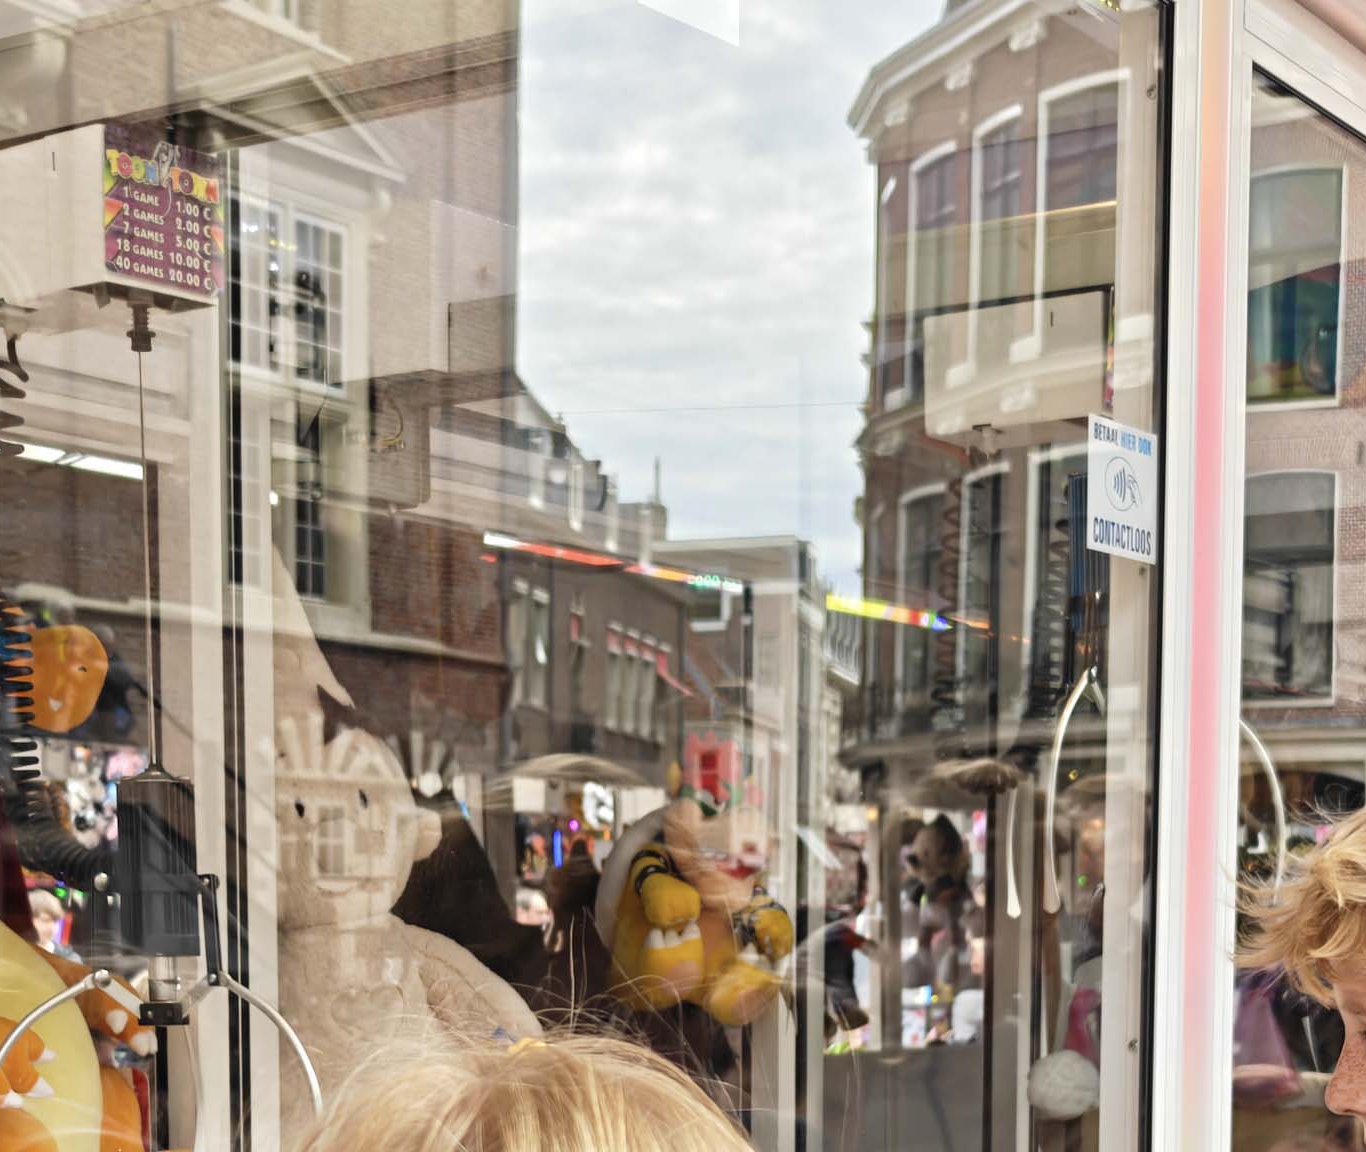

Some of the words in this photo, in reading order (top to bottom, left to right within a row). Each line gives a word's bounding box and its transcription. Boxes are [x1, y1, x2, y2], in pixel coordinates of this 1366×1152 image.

[106, 150, 160, 186] TOON
[170, 166, 220, 204] TOWN
[123, 185, 129, 198] 1
[133, 191, 160, 207] GAME
[176, 201, 200, 217] 1.00
[123, 204, 130, 216] 2
[133, 210, 165, 226] GAMES
[176, 218, 200, 234] 2.00
[123, 221, 129, 234] 7
[133, 227, 165, 243] GAMES
[176, 235, 200, 252] 5.00
[117, 239, 130, 252] 18
[133, 245, 164, 261] GAMES
[169, 252, 200, 270] 10.00
[116, 257, 131, 270] 40
[133, 262, 164, 279] GAMES
[169, 270, 200, 288] 20.00
[1094, 422, 1119, 447] BETAAL
[1093, 517, 1152, 556] CONTACTLOOS
